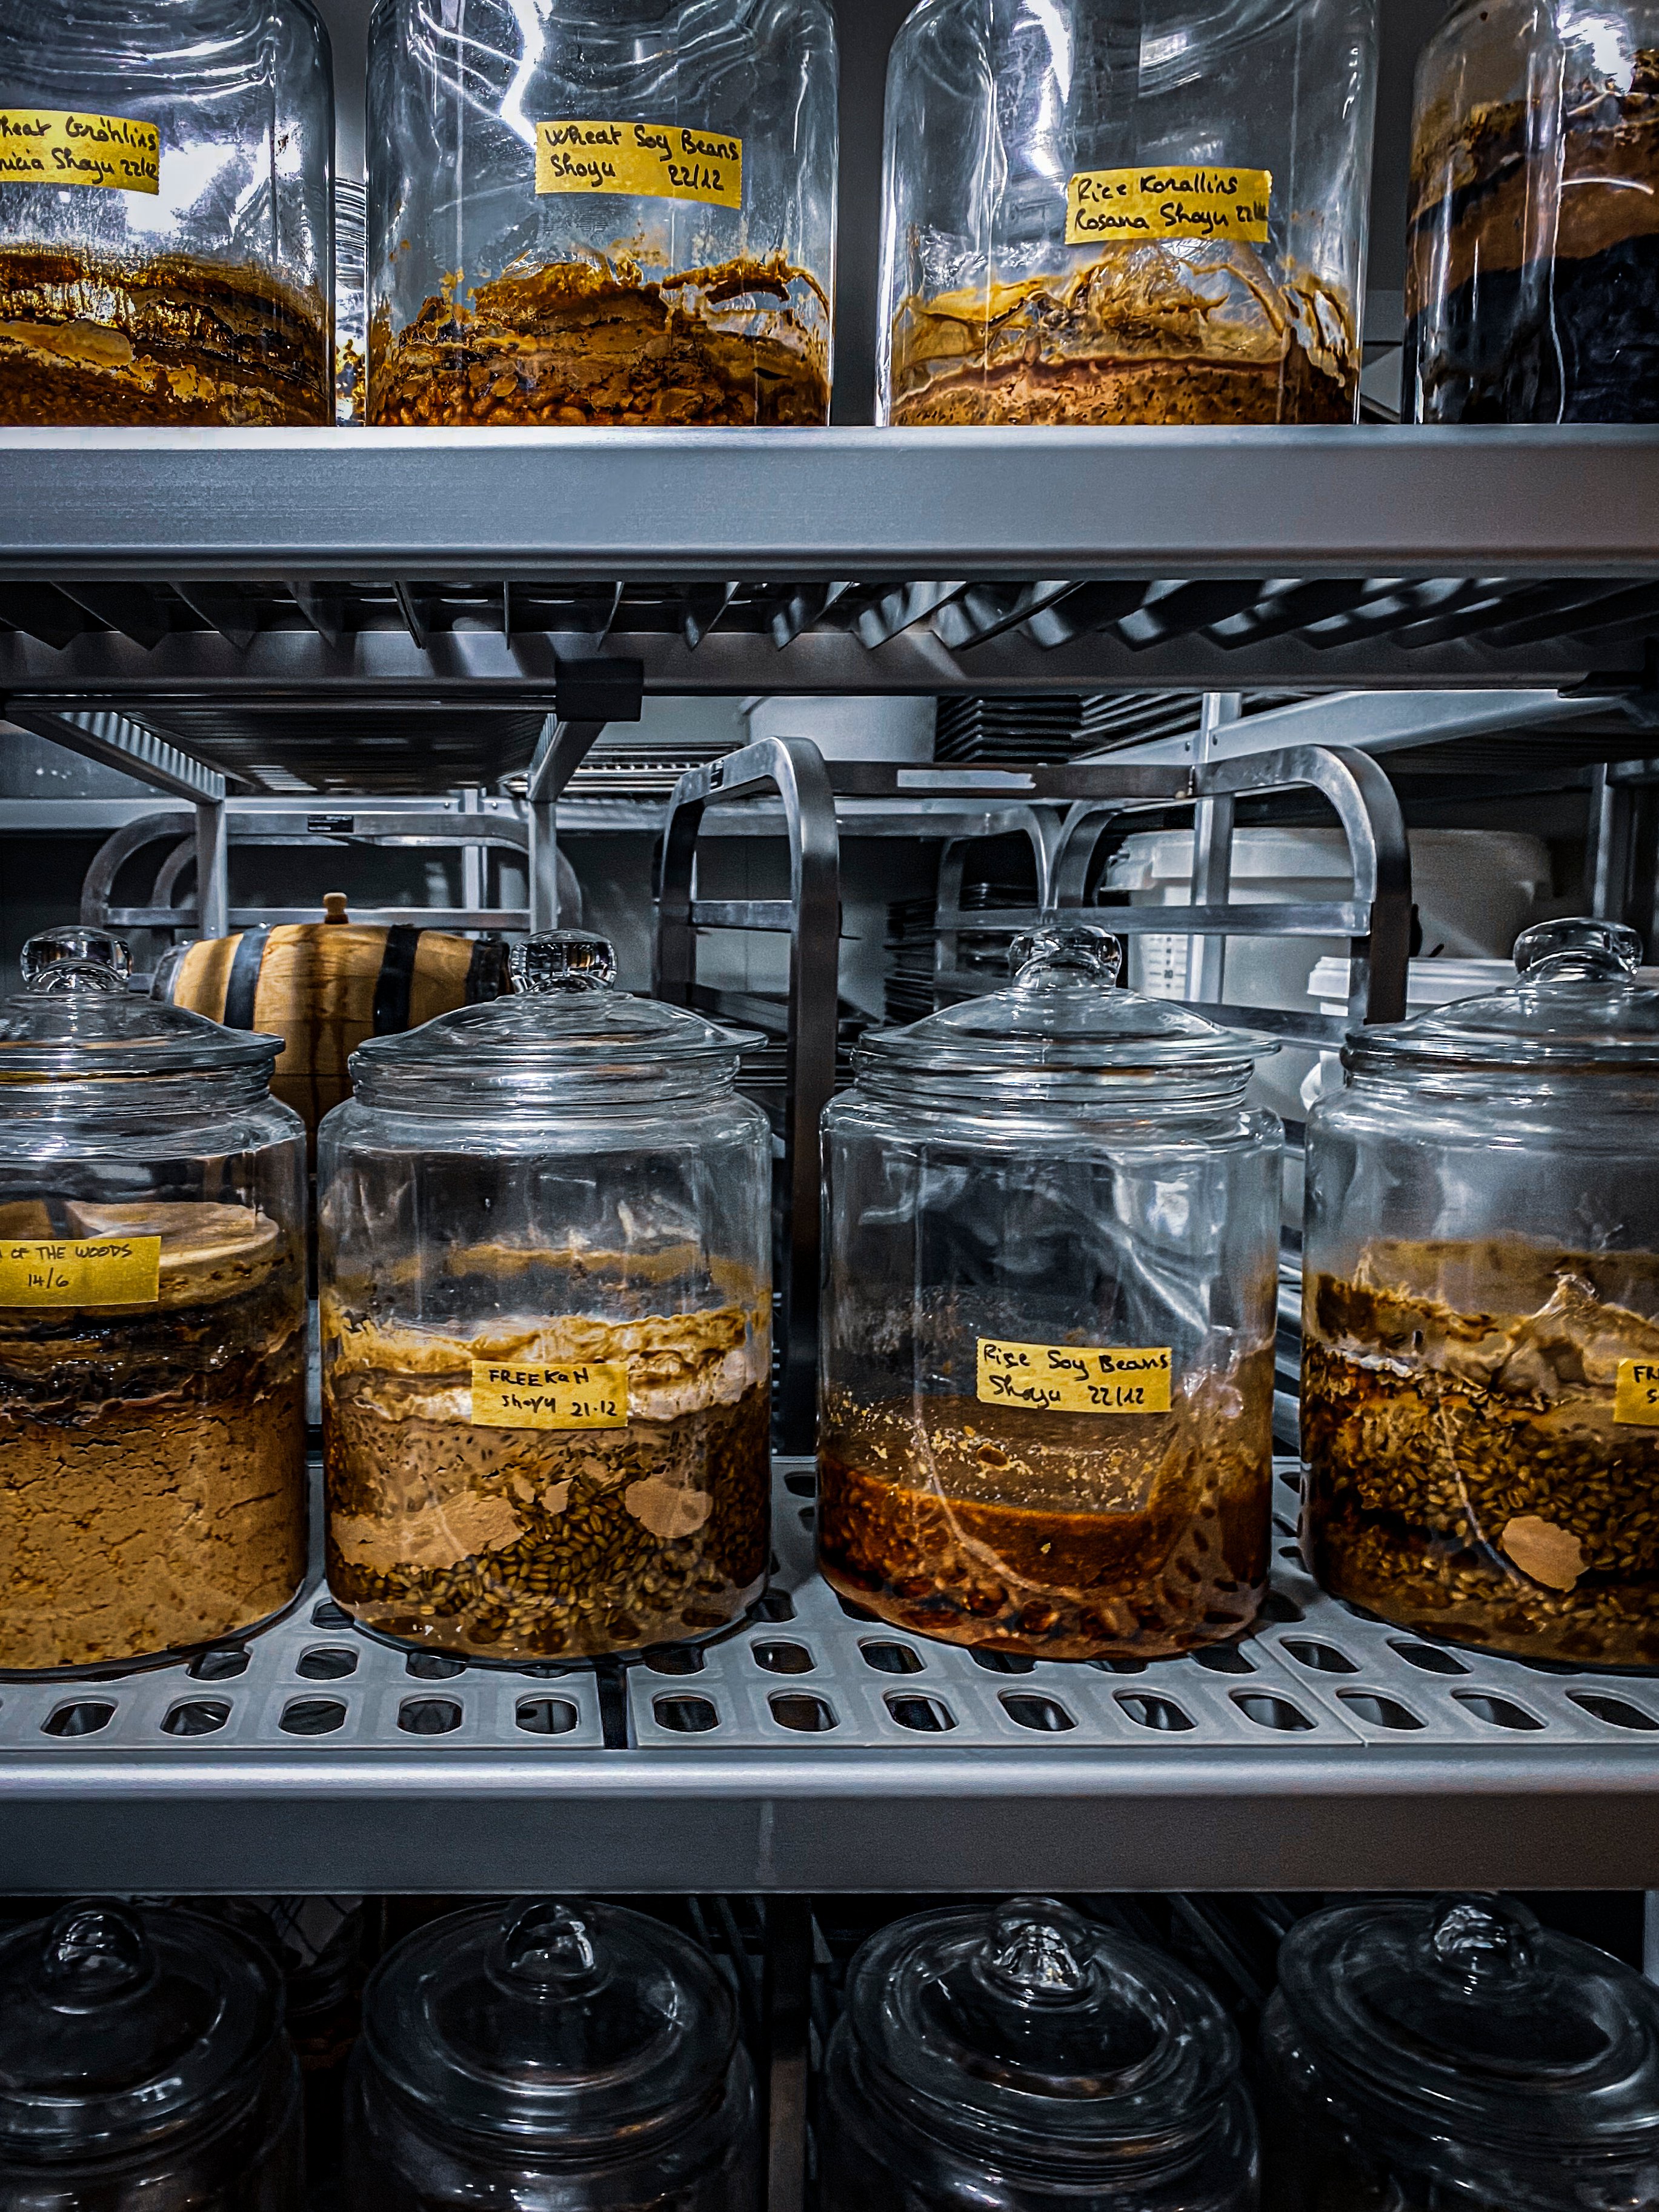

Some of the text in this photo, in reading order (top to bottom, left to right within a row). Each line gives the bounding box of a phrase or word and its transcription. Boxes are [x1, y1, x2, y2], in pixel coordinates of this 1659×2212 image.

[545, 124, 740, 162] Wheat Soy Beans
[550, 151, 725, 191] Shoyu 22/12
[1077, 177, 1128, 205] Rice
[35, 1244, 67, 1260] THE
[75, 1243, 133, 1258] WOODS
[28, 1267, 70, 1289] 14/6
[1047, 1350, 1090, 1381] Soy
[1098, 1353, 1169, 1373] Beans
[1633, 1364, 1659, 1384] FR
[1088, 1385, 1145, 1407] 22/12
